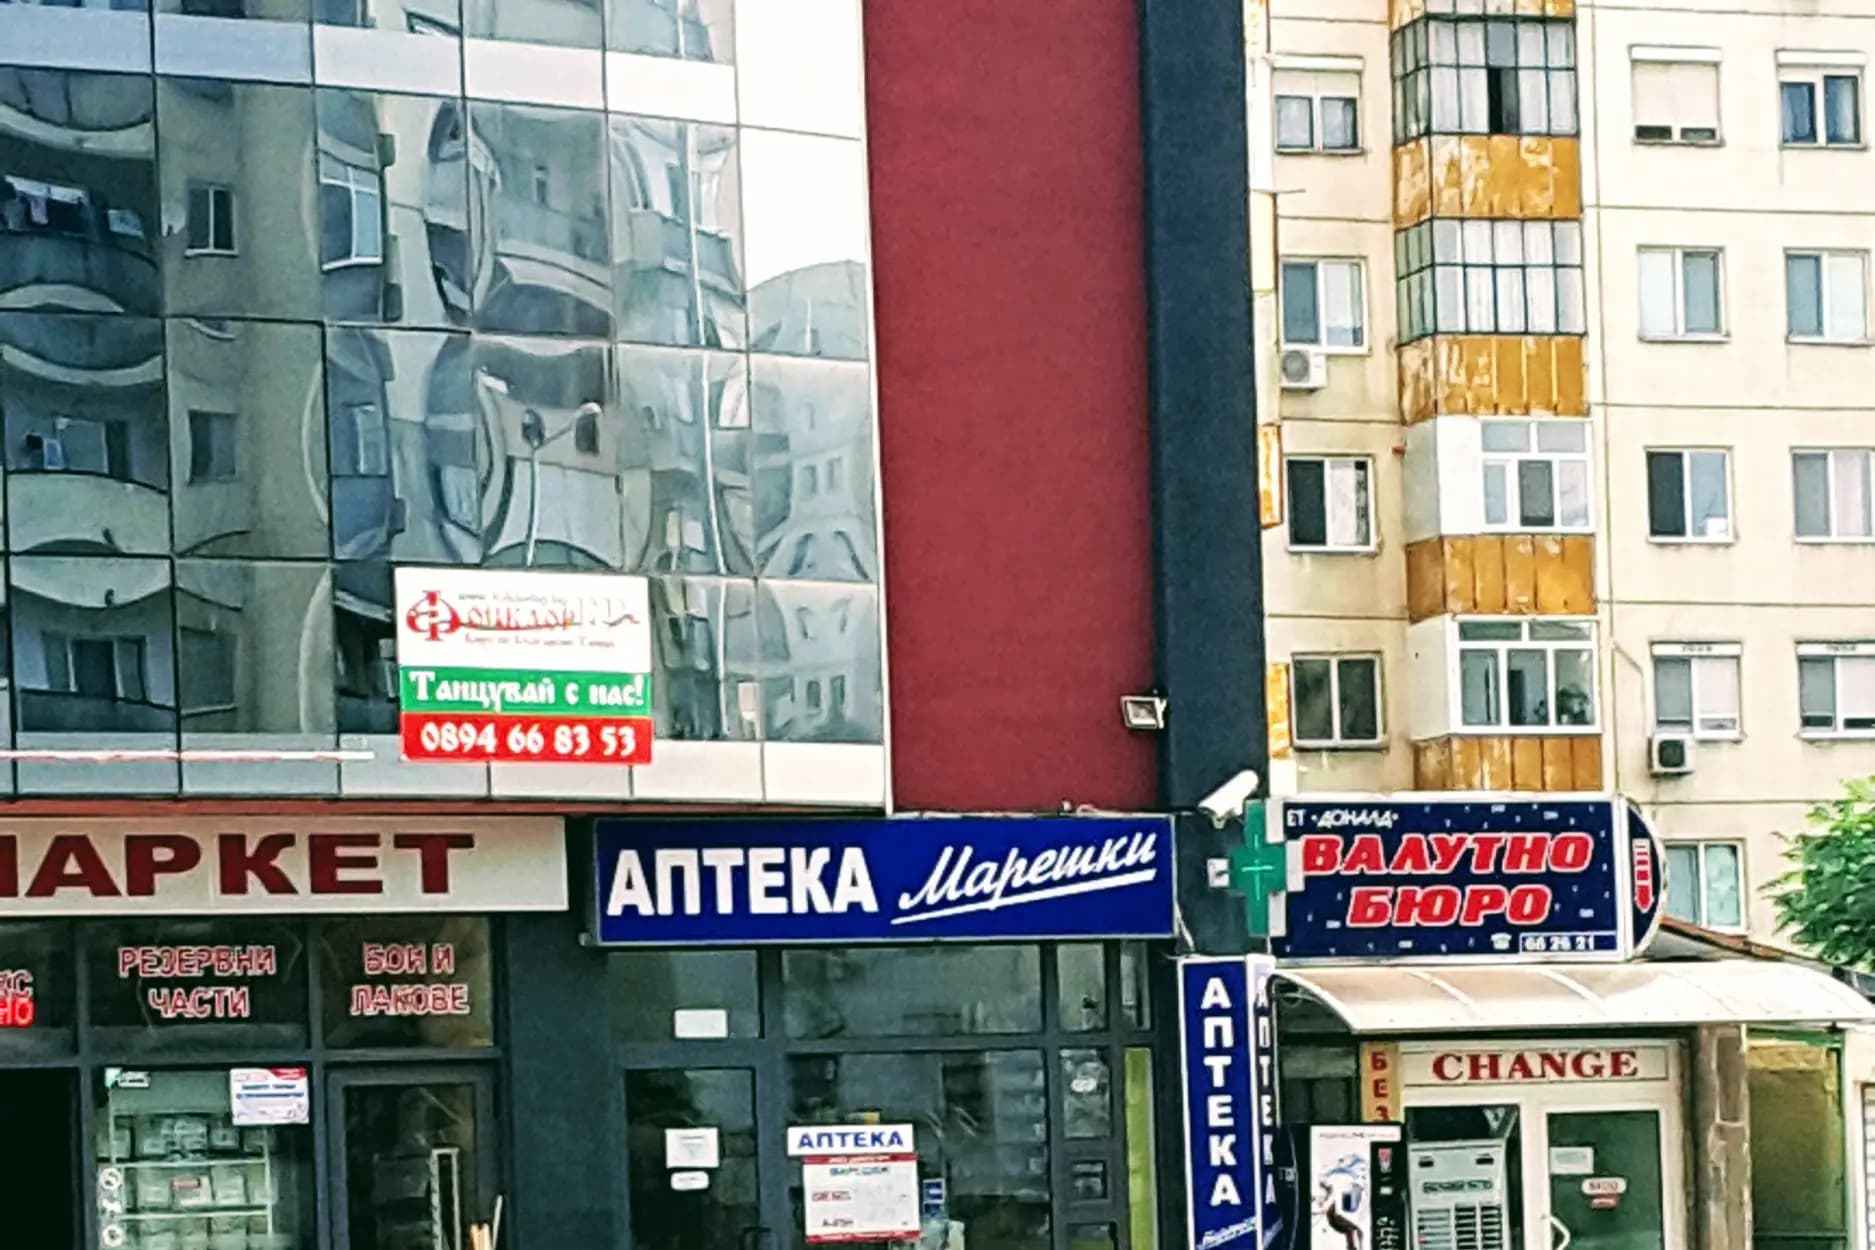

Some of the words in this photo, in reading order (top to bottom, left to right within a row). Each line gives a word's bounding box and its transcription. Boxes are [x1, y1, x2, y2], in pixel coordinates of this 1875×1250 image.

[408, 671, 556, 712] Танцувай
[565, 682, 580, 704] с
[589, 674, 645, 706] нас!
[420, 721, 498, 753] 0894
[507, 723, 545, 754] 66
[554, 725, 591, 756] 83
[600, 727, 636, 757] 53
[1302, 832, 1594, 875] ВАЛУТНО
[607, 847, 878, 915] АПТЕКА
[898, 832, 1157, 912] Марешки
[1347, 884, 1552, 927] БЮРО
[118, 945, 277, 978] РЕЗЕРВНИ
[363, 942, 427, 975] БОИ
[432, 943, 455, 975] И
[148, 985, 249, 1018] ЧАСТИ
[350, 983, 471, 1016] ЛАКОВЕ
[1432, 1050, 1638, 1081] CHANGE
[1200, 977, 1241, 1206] АПТЕКА
[798, 1130, 904, 1149] АПТЕКА
